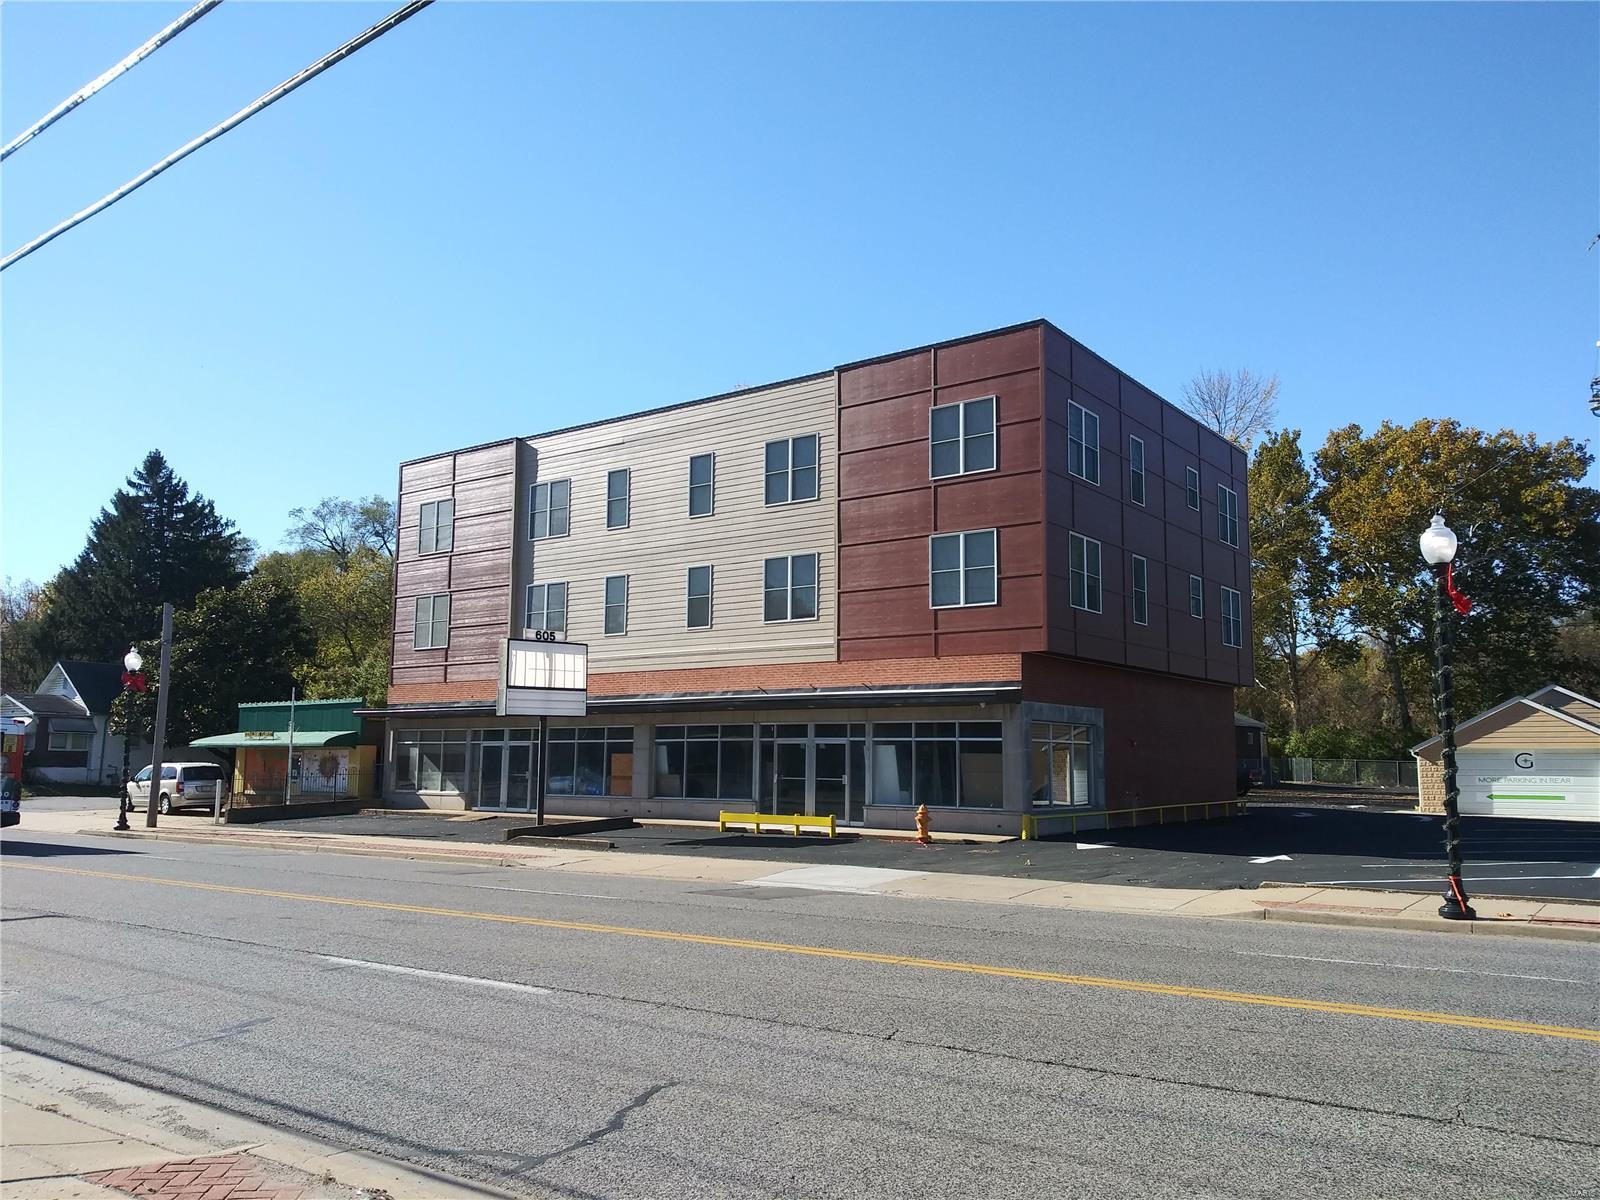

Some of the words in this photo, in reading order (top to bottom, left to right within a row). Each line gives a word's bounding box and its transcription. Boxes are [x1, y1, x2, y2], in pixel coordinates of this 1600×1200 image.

[535, 630, 556, 641] 605
[1478, 776, 1503, 784] MORE
[1504, 776, 1538, 784] PARKING
[1540, 776, 1548, 784] IN
[1549, 776, 1571, 784] REAR
